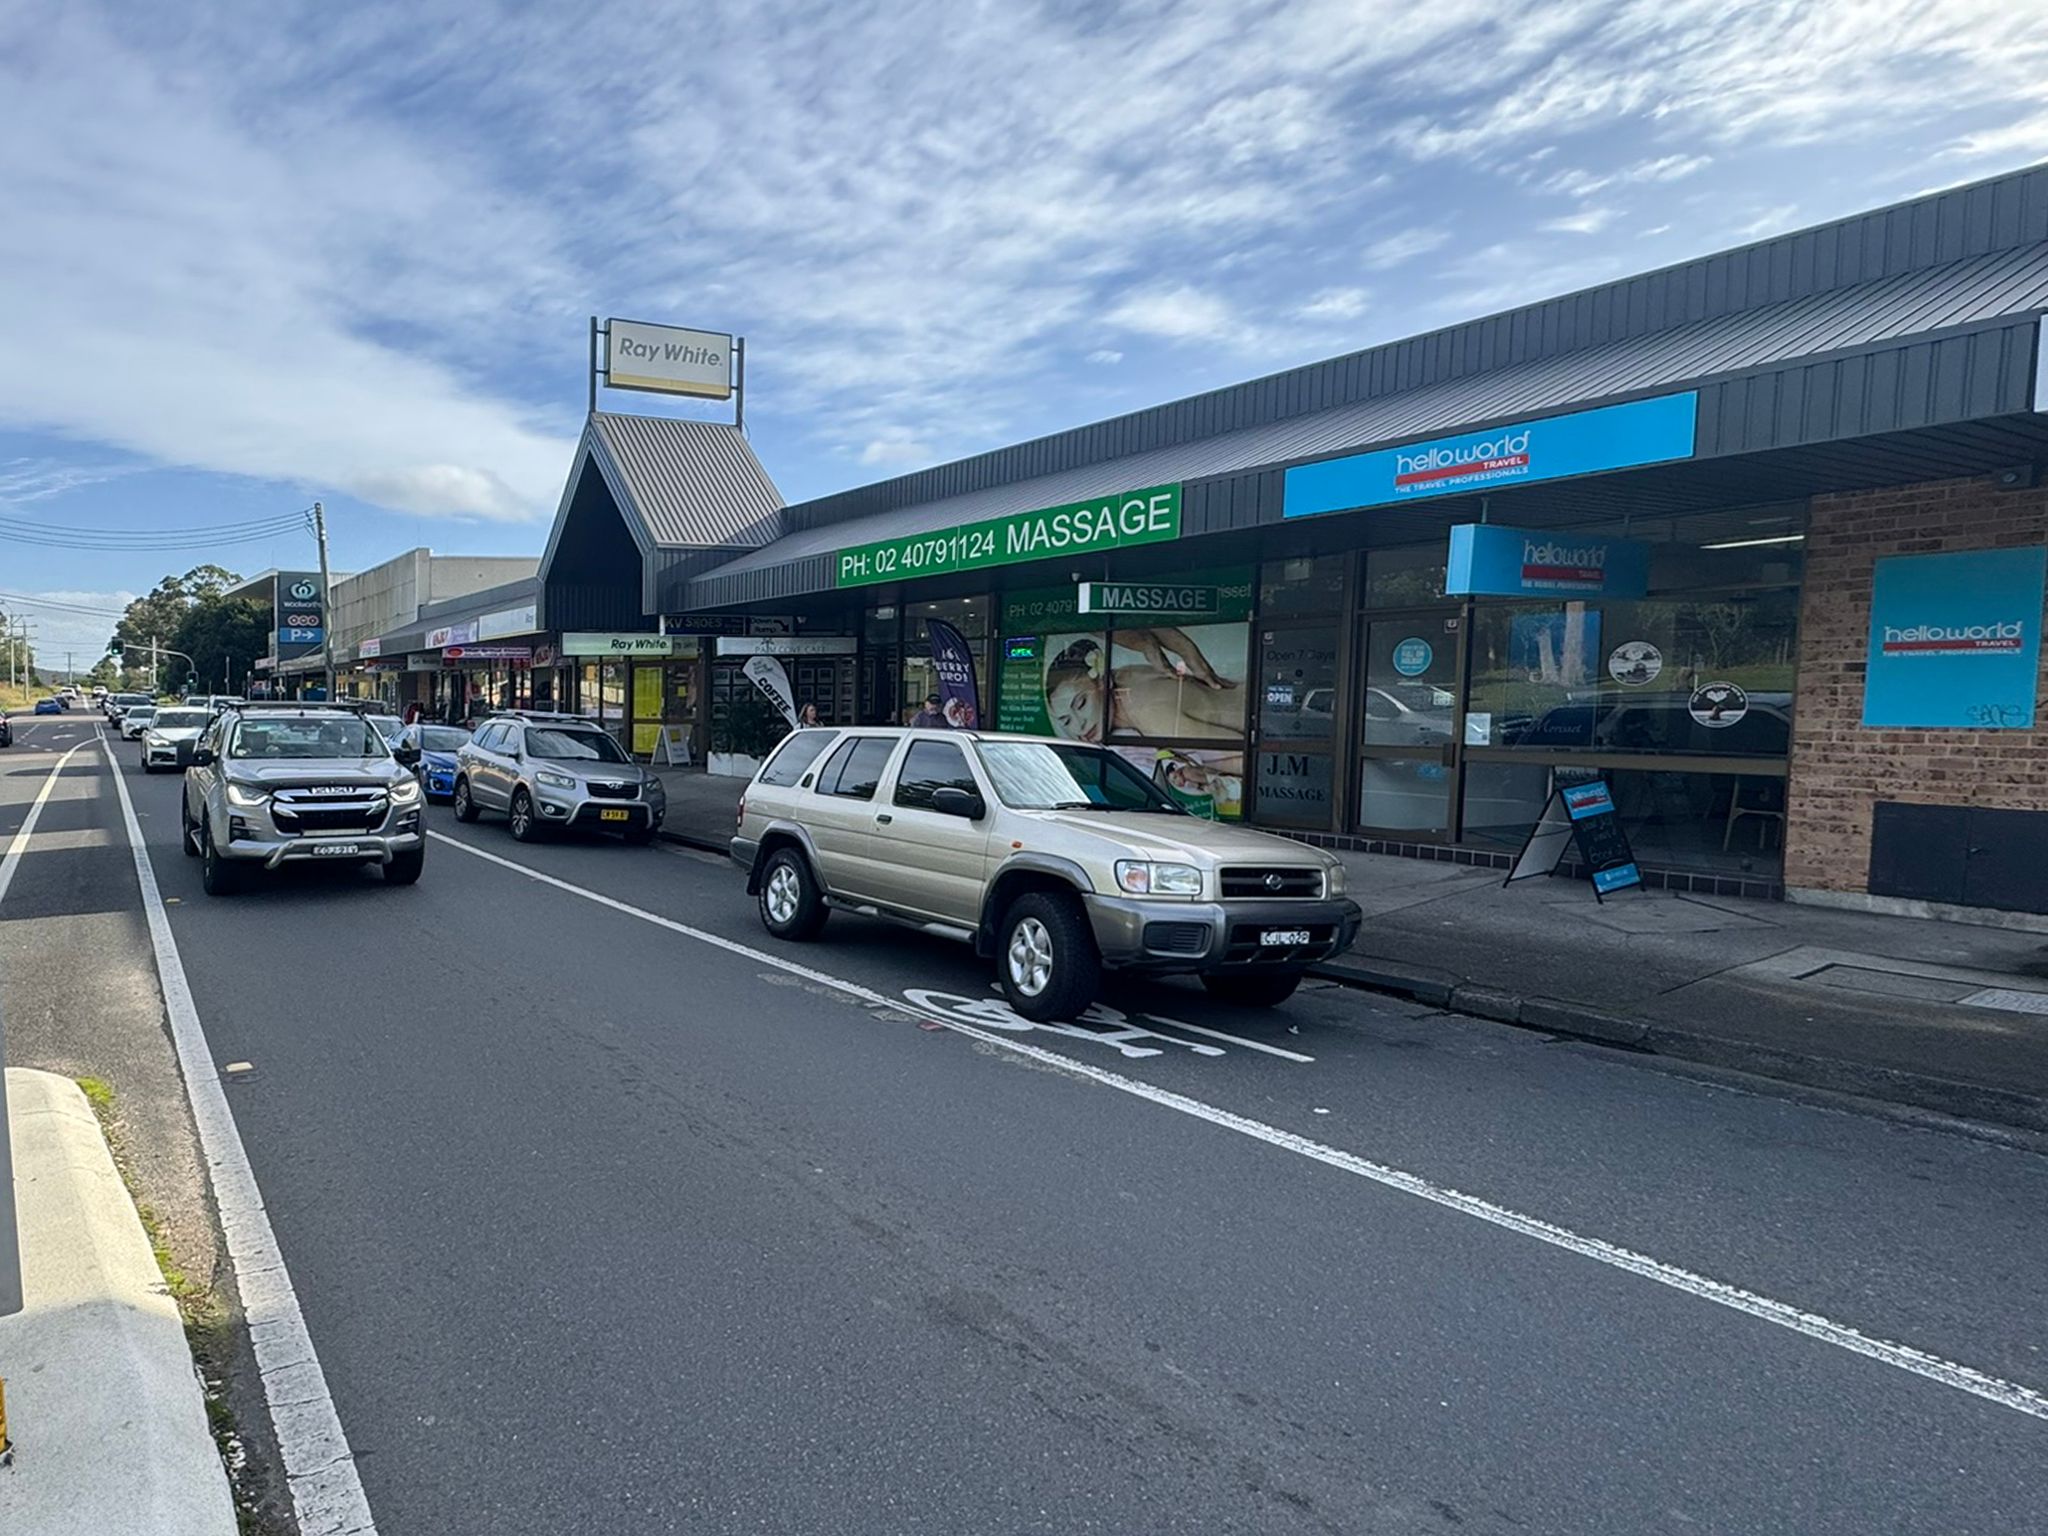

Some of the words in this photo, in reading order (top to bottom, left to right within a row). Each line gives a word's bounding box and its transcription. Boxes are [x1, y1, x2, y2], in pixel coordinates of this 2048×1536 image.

[619, 337, 661, 362] Ray
[1483, 456, 1524, 470] TRAVEL
[1394, 486, 1412, 495] THE
[1413, 480, 1447, 491] TRAVEL
[1448, 466, 1529, 486] PROFESSIONALS
[841, 556, 870, 579] PH:
[875, 549, 896, 574] 02
[901, 530, 995, 568] 40791124
[1006, 493, 1172, 555] MASSAGE
[1102, 587, 1207, 609] MASSAGE
[1030, 601, 1044, 617] 02
[665, 617, 683, 629] KV
[685, 616, 723, 629] SHOES
[291, 629, 302, 641] P
[611, 639, 633, 651] Ray
[758, 677, 793, 714] COFFEE
[1267, 692, 1292, 703] OPEN
[1266, 755, 1309, 776] J.M
[1259, 786, 1326, 802] MASSAGE
